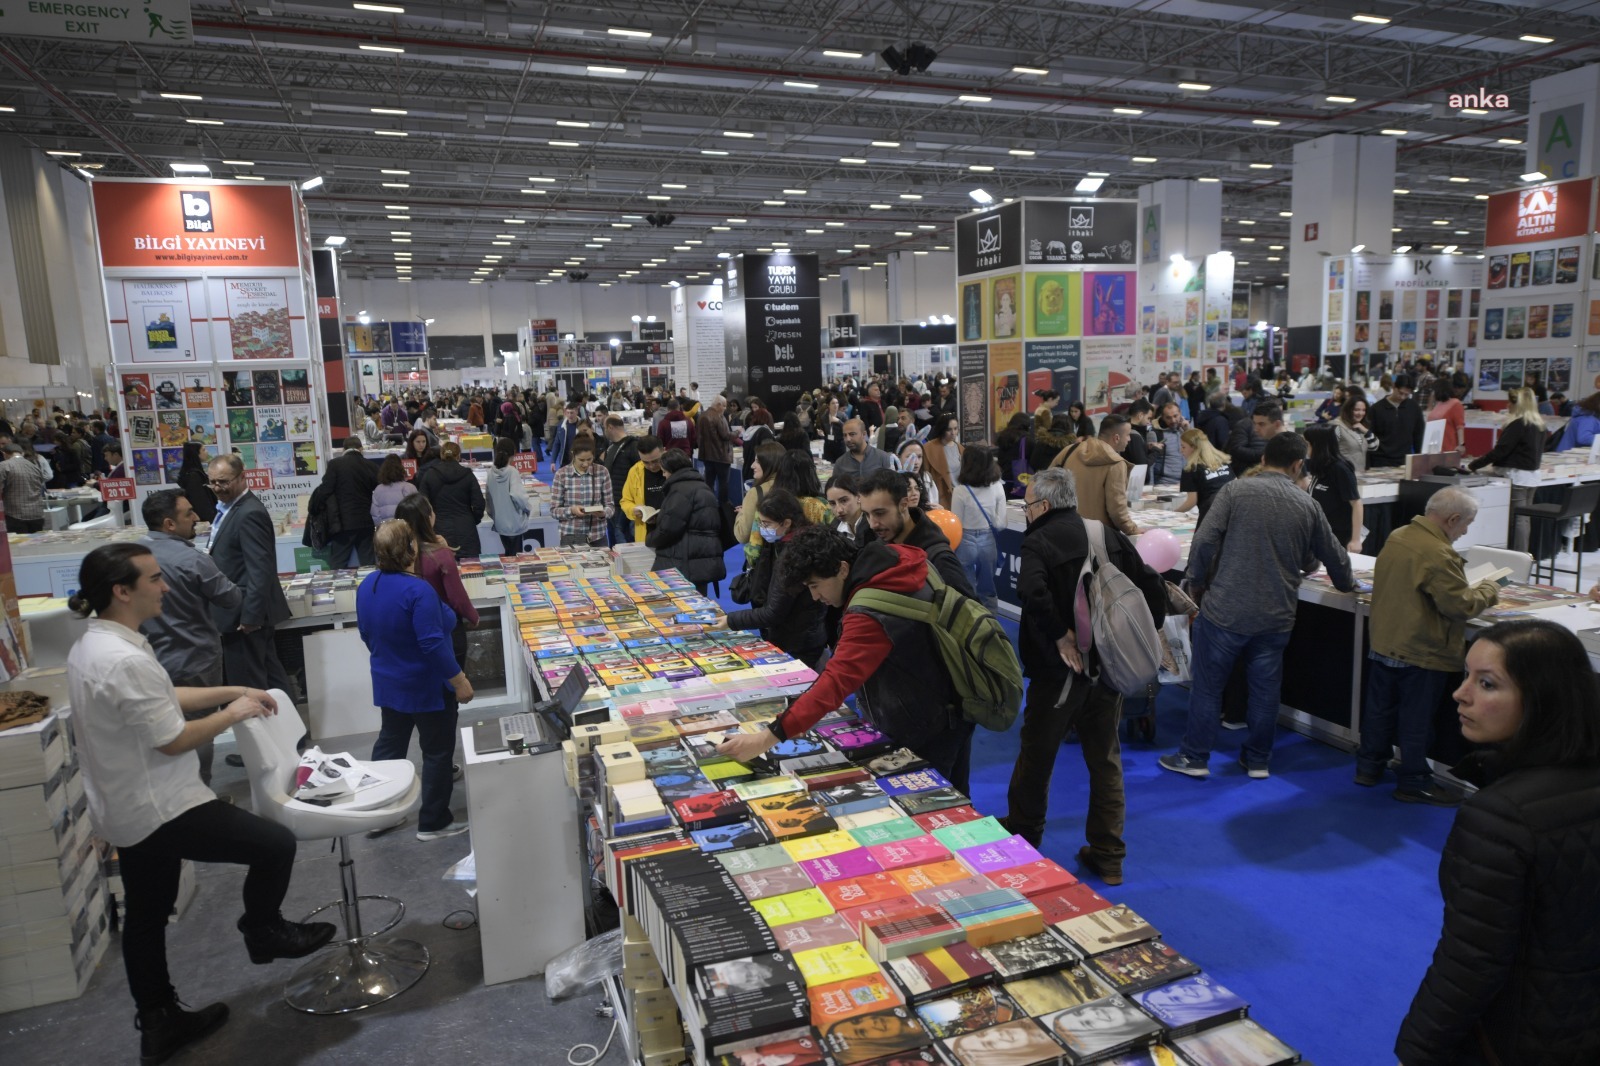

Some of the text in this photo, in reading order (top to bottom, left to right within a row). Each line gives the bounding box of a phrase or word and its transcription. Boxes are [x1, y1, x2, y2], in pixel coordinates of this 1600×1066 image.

[28, 0, 130, 19] EMERGENCY
[65, 21, 100, 34] EXIT
[1545, 114, 1573, 152] A
[186, 219, 212, 231] Bilgi
[1517, 214, 1556, 229] ALTIN
[1516, 226, 1555, 237] KİTAPLAR
[134, 234, 266, 250] BİLGİ YAYINEVİ
[155, 253, 248, 262] www.bilgiyayinevi.com.tr
[976, 254, 1002, 267] ithaki
[767, 266, 796, 275] TUDEM
[768, 276, 796, 284] YAYIN
[768, 285, 796, 294] GRUBU
[778, 331, 802, 339] DESEN
[832, 327, 857, 338] SEL
[524, 460, 533, 468] TL
[255, 477, 266, 486] TL
[108, 488, 130, 498] 20 TL
[888, 778, 902, 788] YER
[821, 992, 839, 1014] Orhan
[829, 990, 851, 1011] Pamuk
